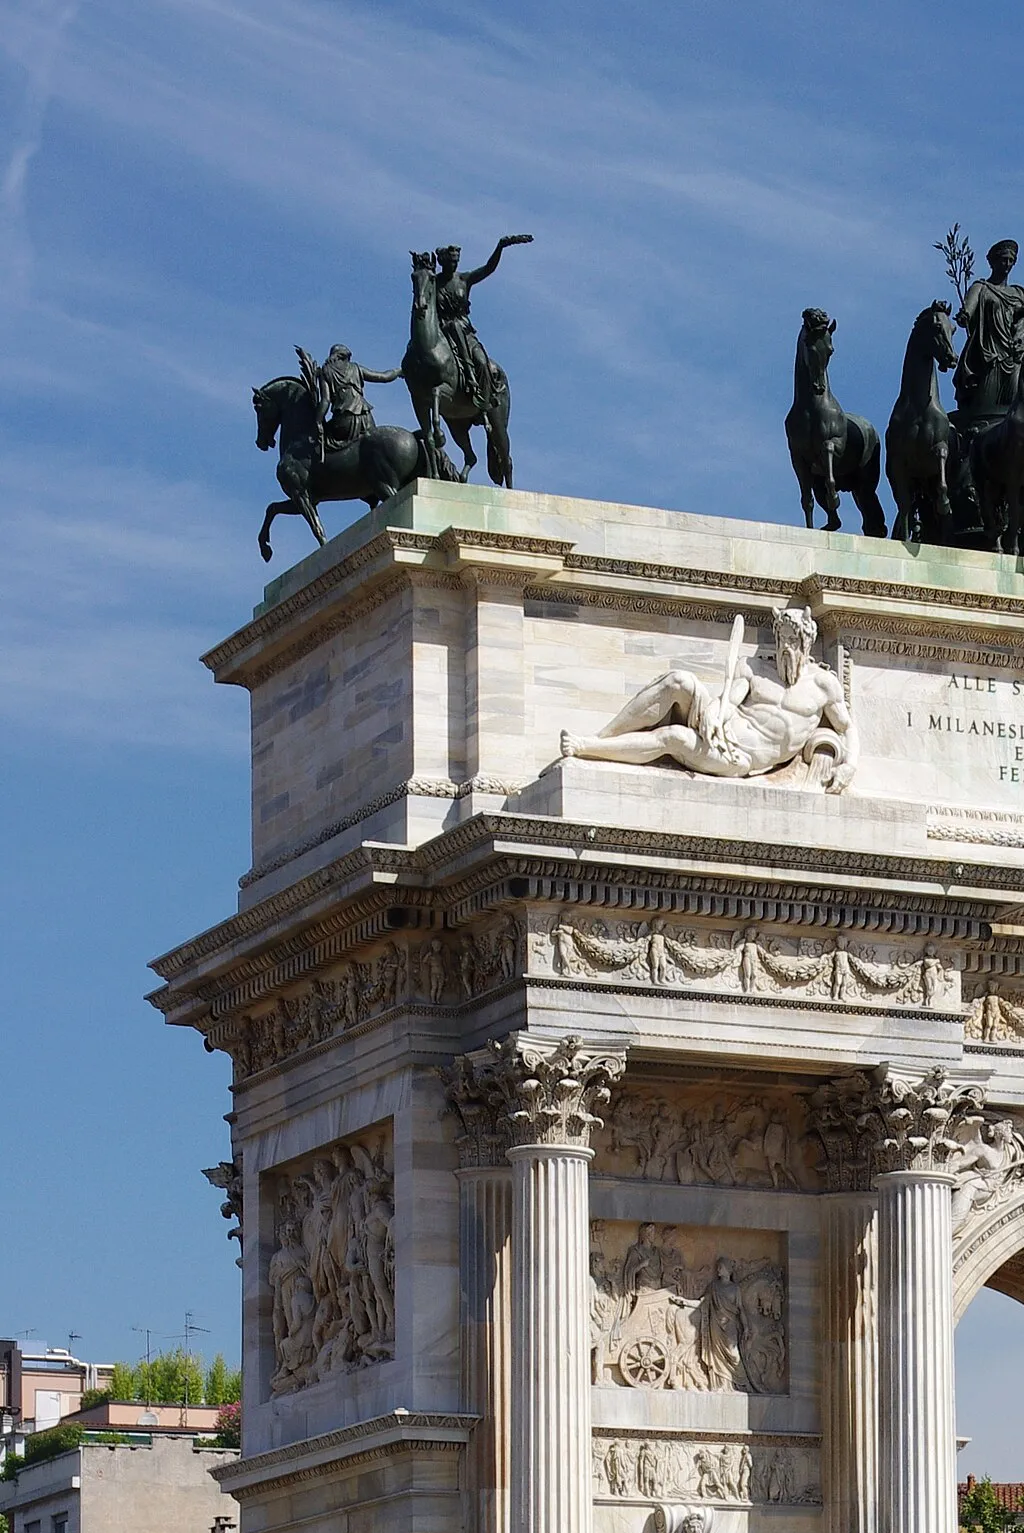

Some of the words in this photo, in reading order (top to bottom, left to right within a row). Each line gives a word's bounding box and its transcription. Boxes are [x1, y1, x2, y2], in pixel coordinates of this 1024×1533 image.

[948, 673, 996, 694] ALLE
[907, 711, 913, 727] I
[928, 714, 1024, 740] MILANESI
[1014, 746, 1024, 761] E
